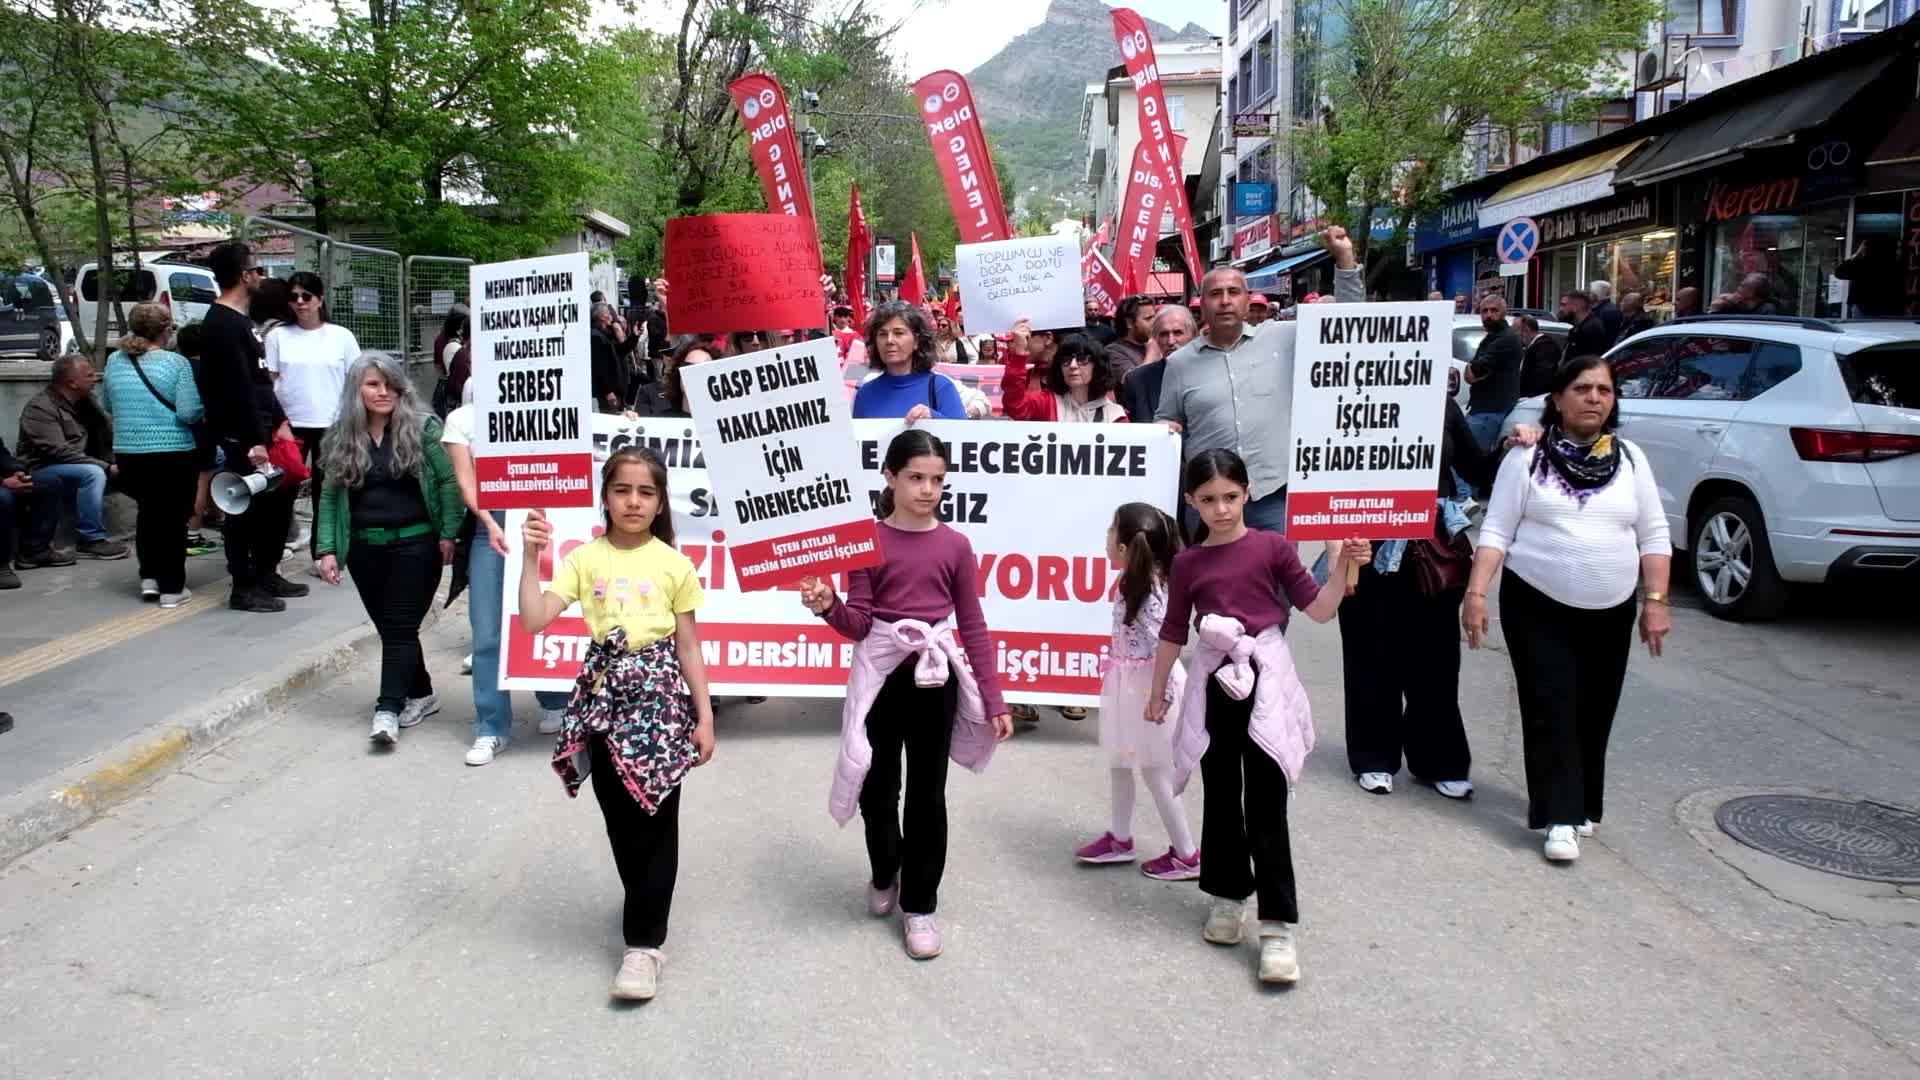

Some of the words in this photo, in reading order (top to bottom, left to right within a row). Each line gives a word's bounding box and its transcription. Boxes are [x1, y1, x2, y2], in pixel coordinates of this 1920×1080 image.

[1134, 170, 1163, 190] DİS
[1705, 177, 1799, 222] Kerem
[1129, 193, 1156, 258] GENE
[1048, 246, 1065, 257] VE
[485, 277, 525, 300] MEHMET
[525, 269, 573, 296] TÜRKMEN
[480, 305, 521, 332] İNSANCA
[522, 304, 556, 333] YAŞAM
[558, 297, 579, 330] İÇİN
[1319, 315, 1430, 345] KAYYUMLAR
[494, 335, 544, 361] MÜCADELE
[546, 329, 565, 357] ETTİ
[498, 368, 563, 404] SERBEST
[707, 369, 753, 402] GASP
[755, 352, 820, 392] EDİLEN
[1310, 352, 1351, 388] GERİ
[1354, 350, 1433, 395] ÇEKİLSİN
[488, 407, 579, 443] BIRAKILSIN
[717, 397, 831, 444] HAKLARIMIZ
[1336, 394, 1401, 437] İŞÇİLER
[507, 460, 529, 478] İŞTEN
[529, 462, 559, 475] ATILAN
[762, 439, 804, 482] İÇİN
[944, 432, 1147, 477] LECEĞİMİZE
[1295, 437, 1321, 480] İŞE
[1324, 437, 1366, 472] İADE
[1368, 435, 1435, 471] EDİLSİN
[480, 477, 510, 492] DERSİM
[511, 475, 554, 492] BELEDİYESİ
[555, 474, 589, 494] İŞÇİLERİ
[735, 472, 853, 524] DİRENECEĞİZ!
[1292, 511, 1331, 526] DERSİM
[1332, 510, 1387, 525] BELEDİYESİ
[1388, 509, 1430, 526] İŞÇİLERİ
[1329, 496, 1357, 513] İŞTEN
[1357, 497, 1394, 510] ATILAN
[741, 559, 780, 577] DERSİM
[780, 550, 835, 569] BELEDİYESİ
[834, 538, 875, 561] İŞÇİLERİ
[772, 541, 800, 557] İŞTEN
[800, 533, 837, 549] ATILAN
[532, 630, 592, 669] İŞTE
[727, 633, 832, 668] DERSİM
